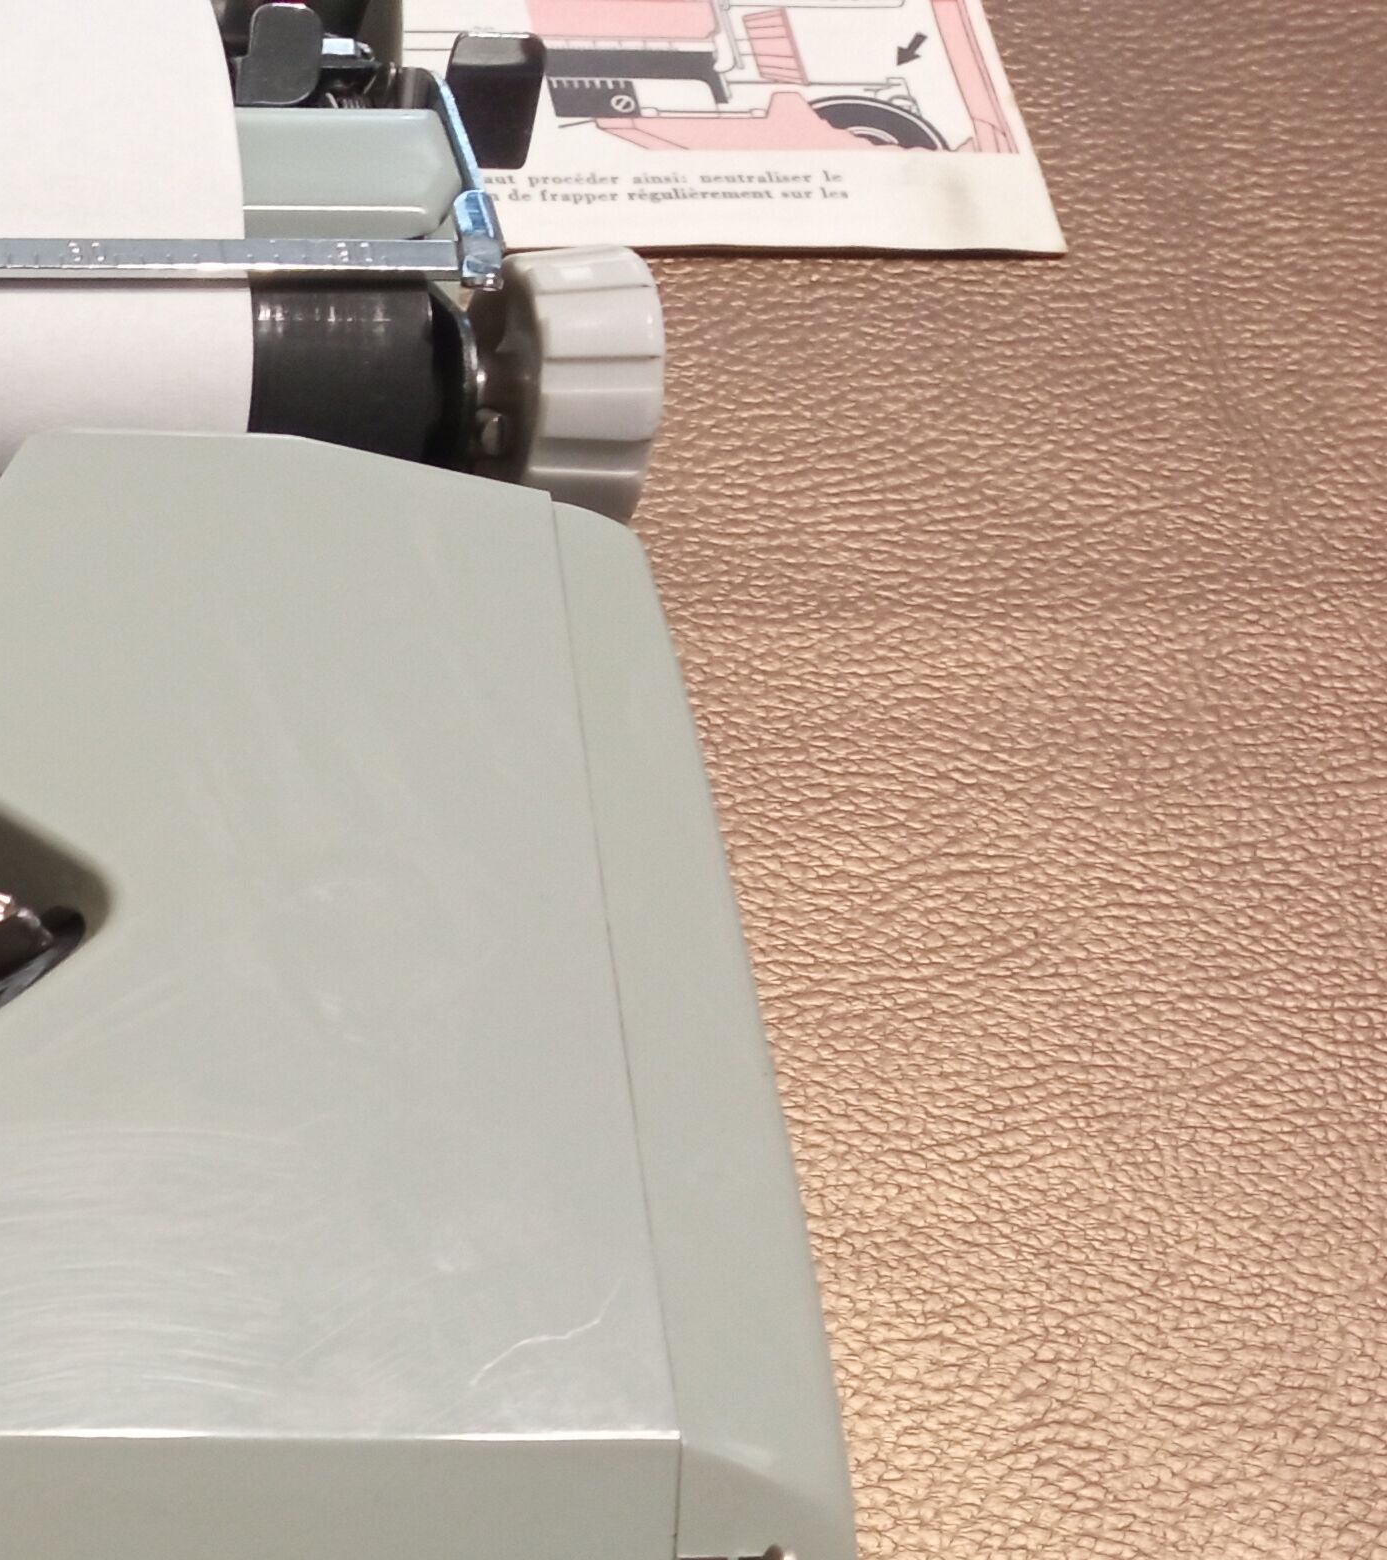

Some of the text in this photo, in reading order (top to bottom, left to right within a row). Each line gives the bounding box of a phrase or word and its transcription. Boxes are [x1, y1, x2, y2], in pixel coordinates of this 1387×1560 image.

[483, 174, 515, 184] aut
[527, 173, 619, 187] procéder
[700, 172, 812, 184] neutraliser
[822, 170, 842, 183] le
[508, 189, 531, 201] de
[540, 190, 619, 204] frapper
[628, 188, 773, 204] régulièrement
[781, 191, 813, 200] sur
[821, 187, 849, 199] les
